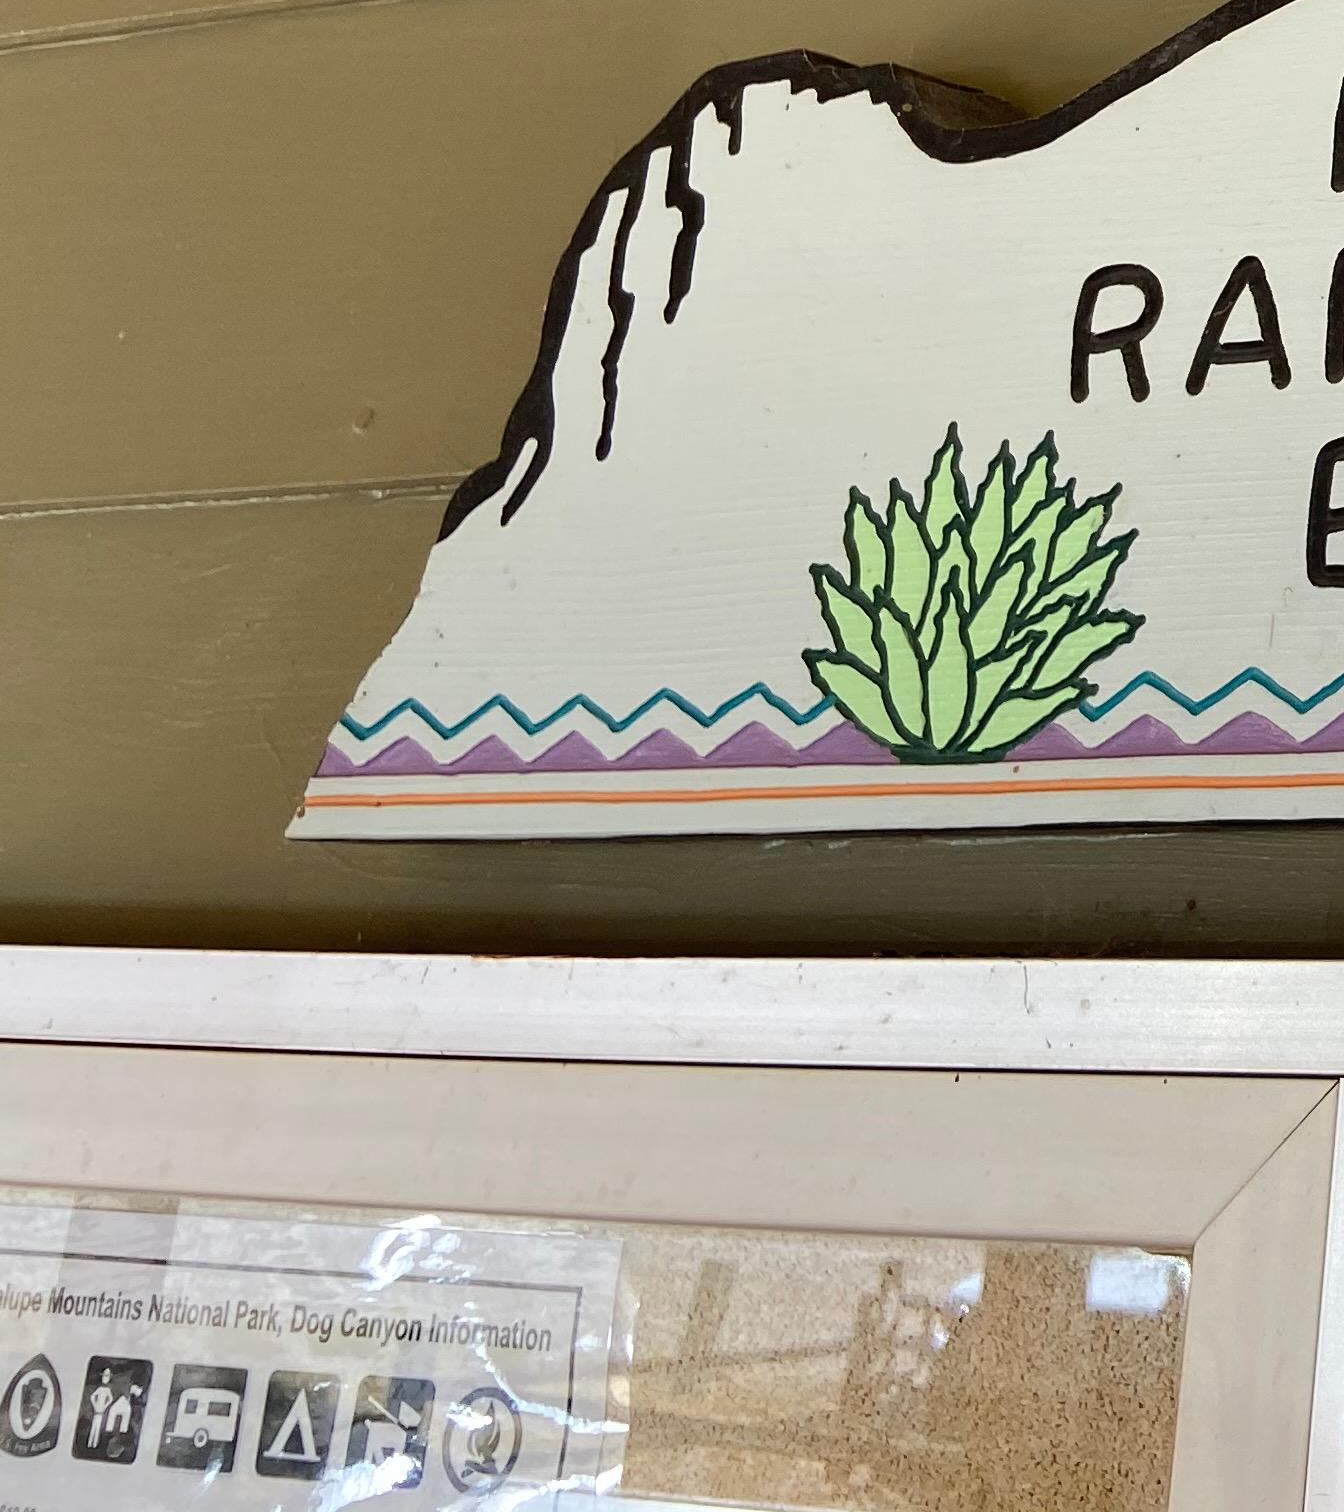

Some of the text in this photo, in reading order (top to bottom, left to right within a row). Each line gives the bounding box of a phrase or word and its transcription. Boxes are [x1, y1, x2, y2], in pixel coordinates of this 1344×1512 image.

[0, 1283, 552, 1352] lupe Mountains National Park, Dog Canyon Information
